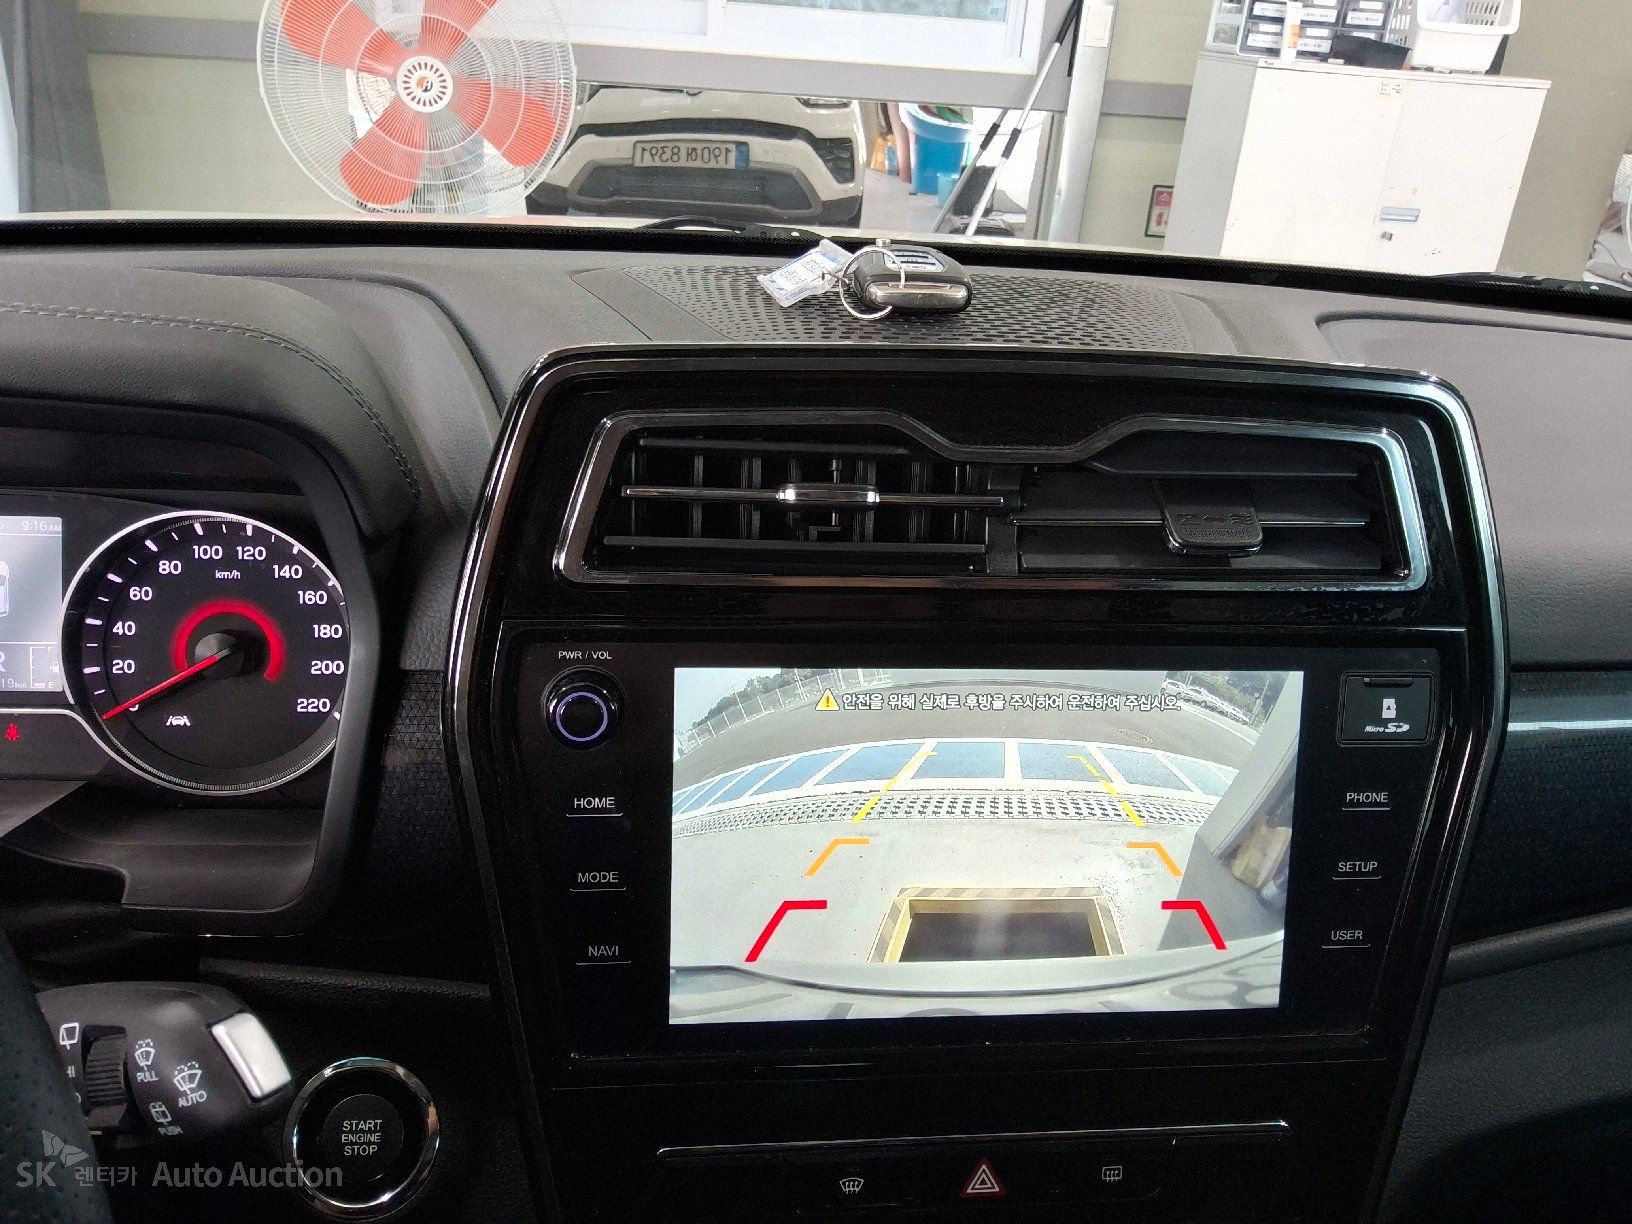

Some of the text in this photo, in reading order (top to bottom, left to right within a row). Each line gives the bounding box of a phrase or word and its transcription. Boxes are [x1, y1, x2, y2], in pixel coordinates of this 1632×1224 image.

[193, 545, 223, 560] 100
[236, 546, 267, 561] 120
[158, 560, 182, 575] 80
[215, 569, 241, 580] km/h
[272, 564, 303, 579] 140
[129, 586, 153, 601] 60
[297, 590, 328, 605] 160
[112, 621, 136, 636] 40
[312, 624, 343, 639] 180
[558, 651, 582, 660] PWR
[592, 651, 613, 659] VOL
[112, 659, 136, 674] 20
[311, 660, 345, 675] 200
[297, 698, 331, 713] 220
[842, 693, 1182, 711] 안전을 위해 실제로 후방을 주시하여 운전하여 주십시오.
[574, 797, 615, 809] HOME
[1346, 792, 1389, 803] PHONE
[1337, 861, 1378, 872] SETUP
[578, 872, 619, 883] MODE
[1331, 930, 1363, 940] USER
[588, 945, 619, 957] NAVI
[136, 1072, 159, 1083] PULL
[178, 1090, 208, 1108] AUTO
[342, 1120, 382, 1131] START
[342, 1133, 382, 1143] ENGINE
[343, 1145, 378, 1156] STOP
